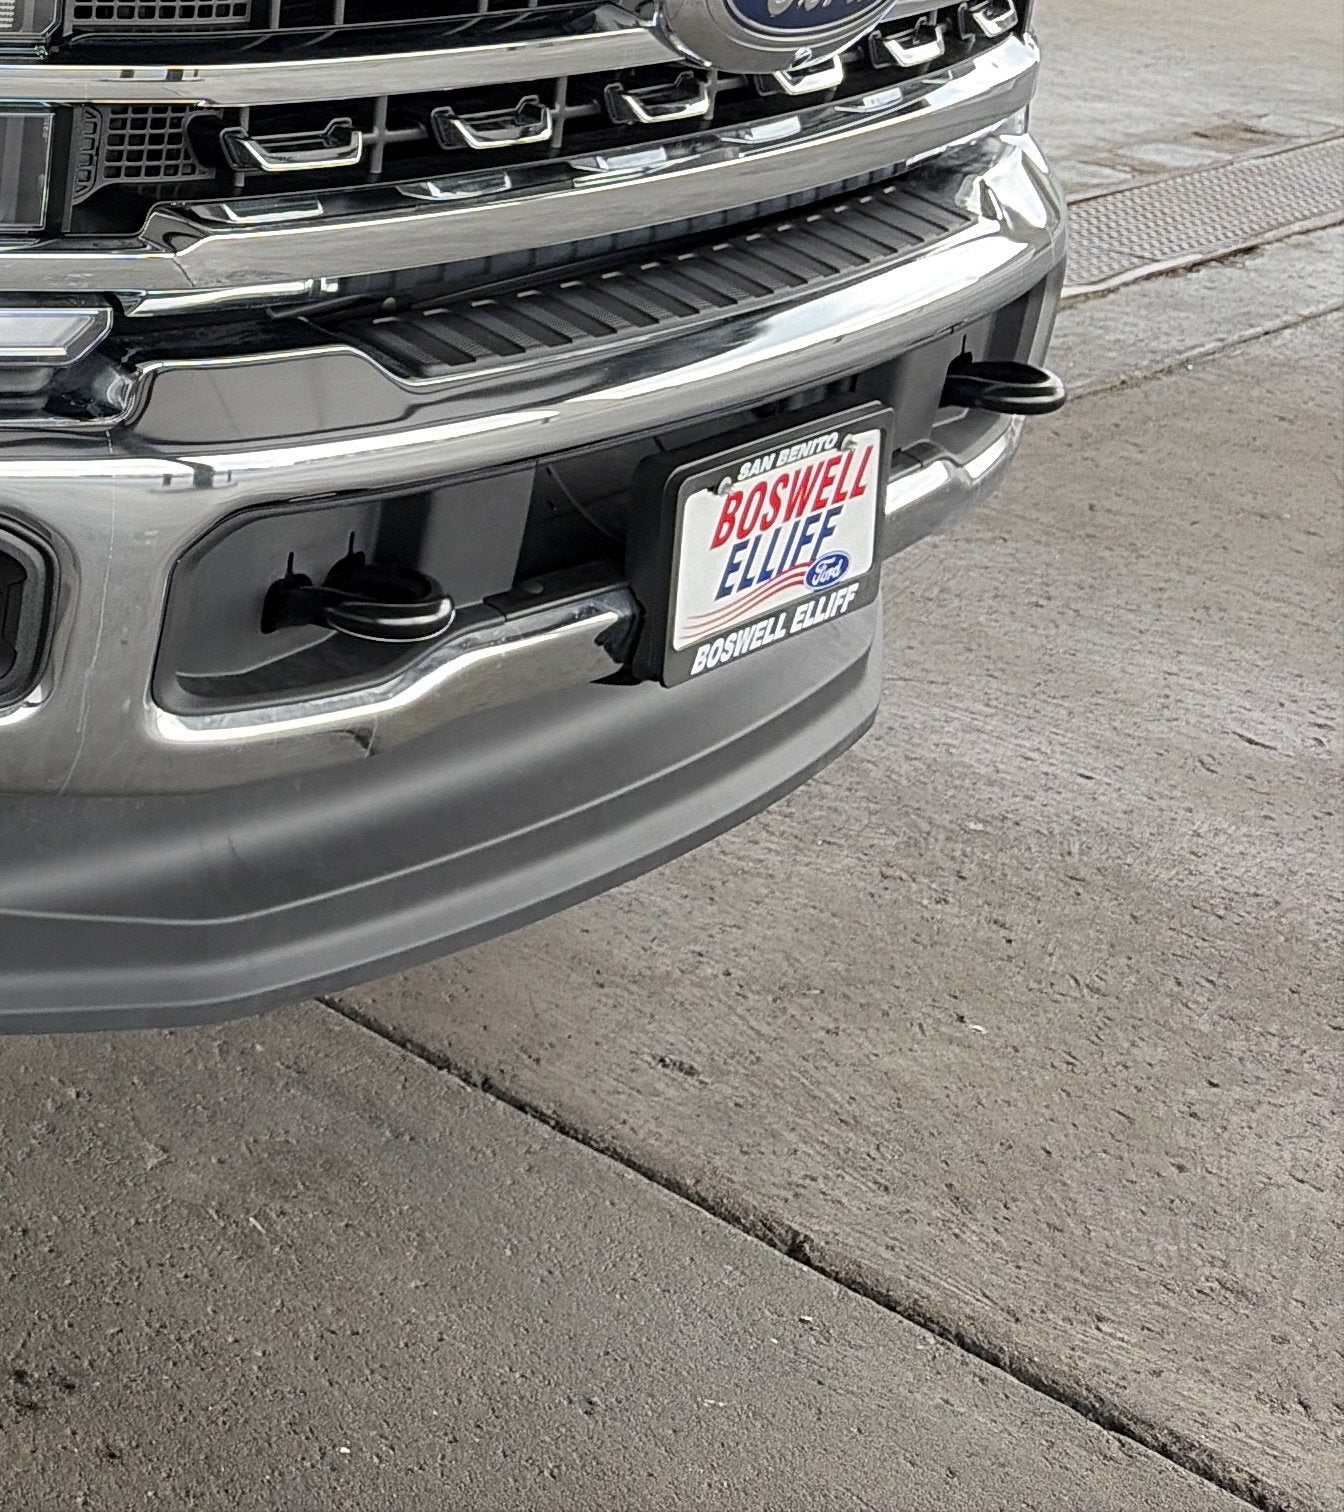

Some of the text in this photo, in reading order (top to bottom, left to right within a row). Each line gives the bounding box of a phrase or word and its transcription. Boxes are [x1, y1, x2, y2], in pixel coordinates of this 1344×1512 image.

[709, 445, 874, 550] BOSWELL
[737, 432, 839, 481] SAN BENITO
[714, 504, 845, 602] ELLIFF
[812, 554, 844, 585] Ford
[690, 583, 860, 676] BOSWELL ELLIFF
